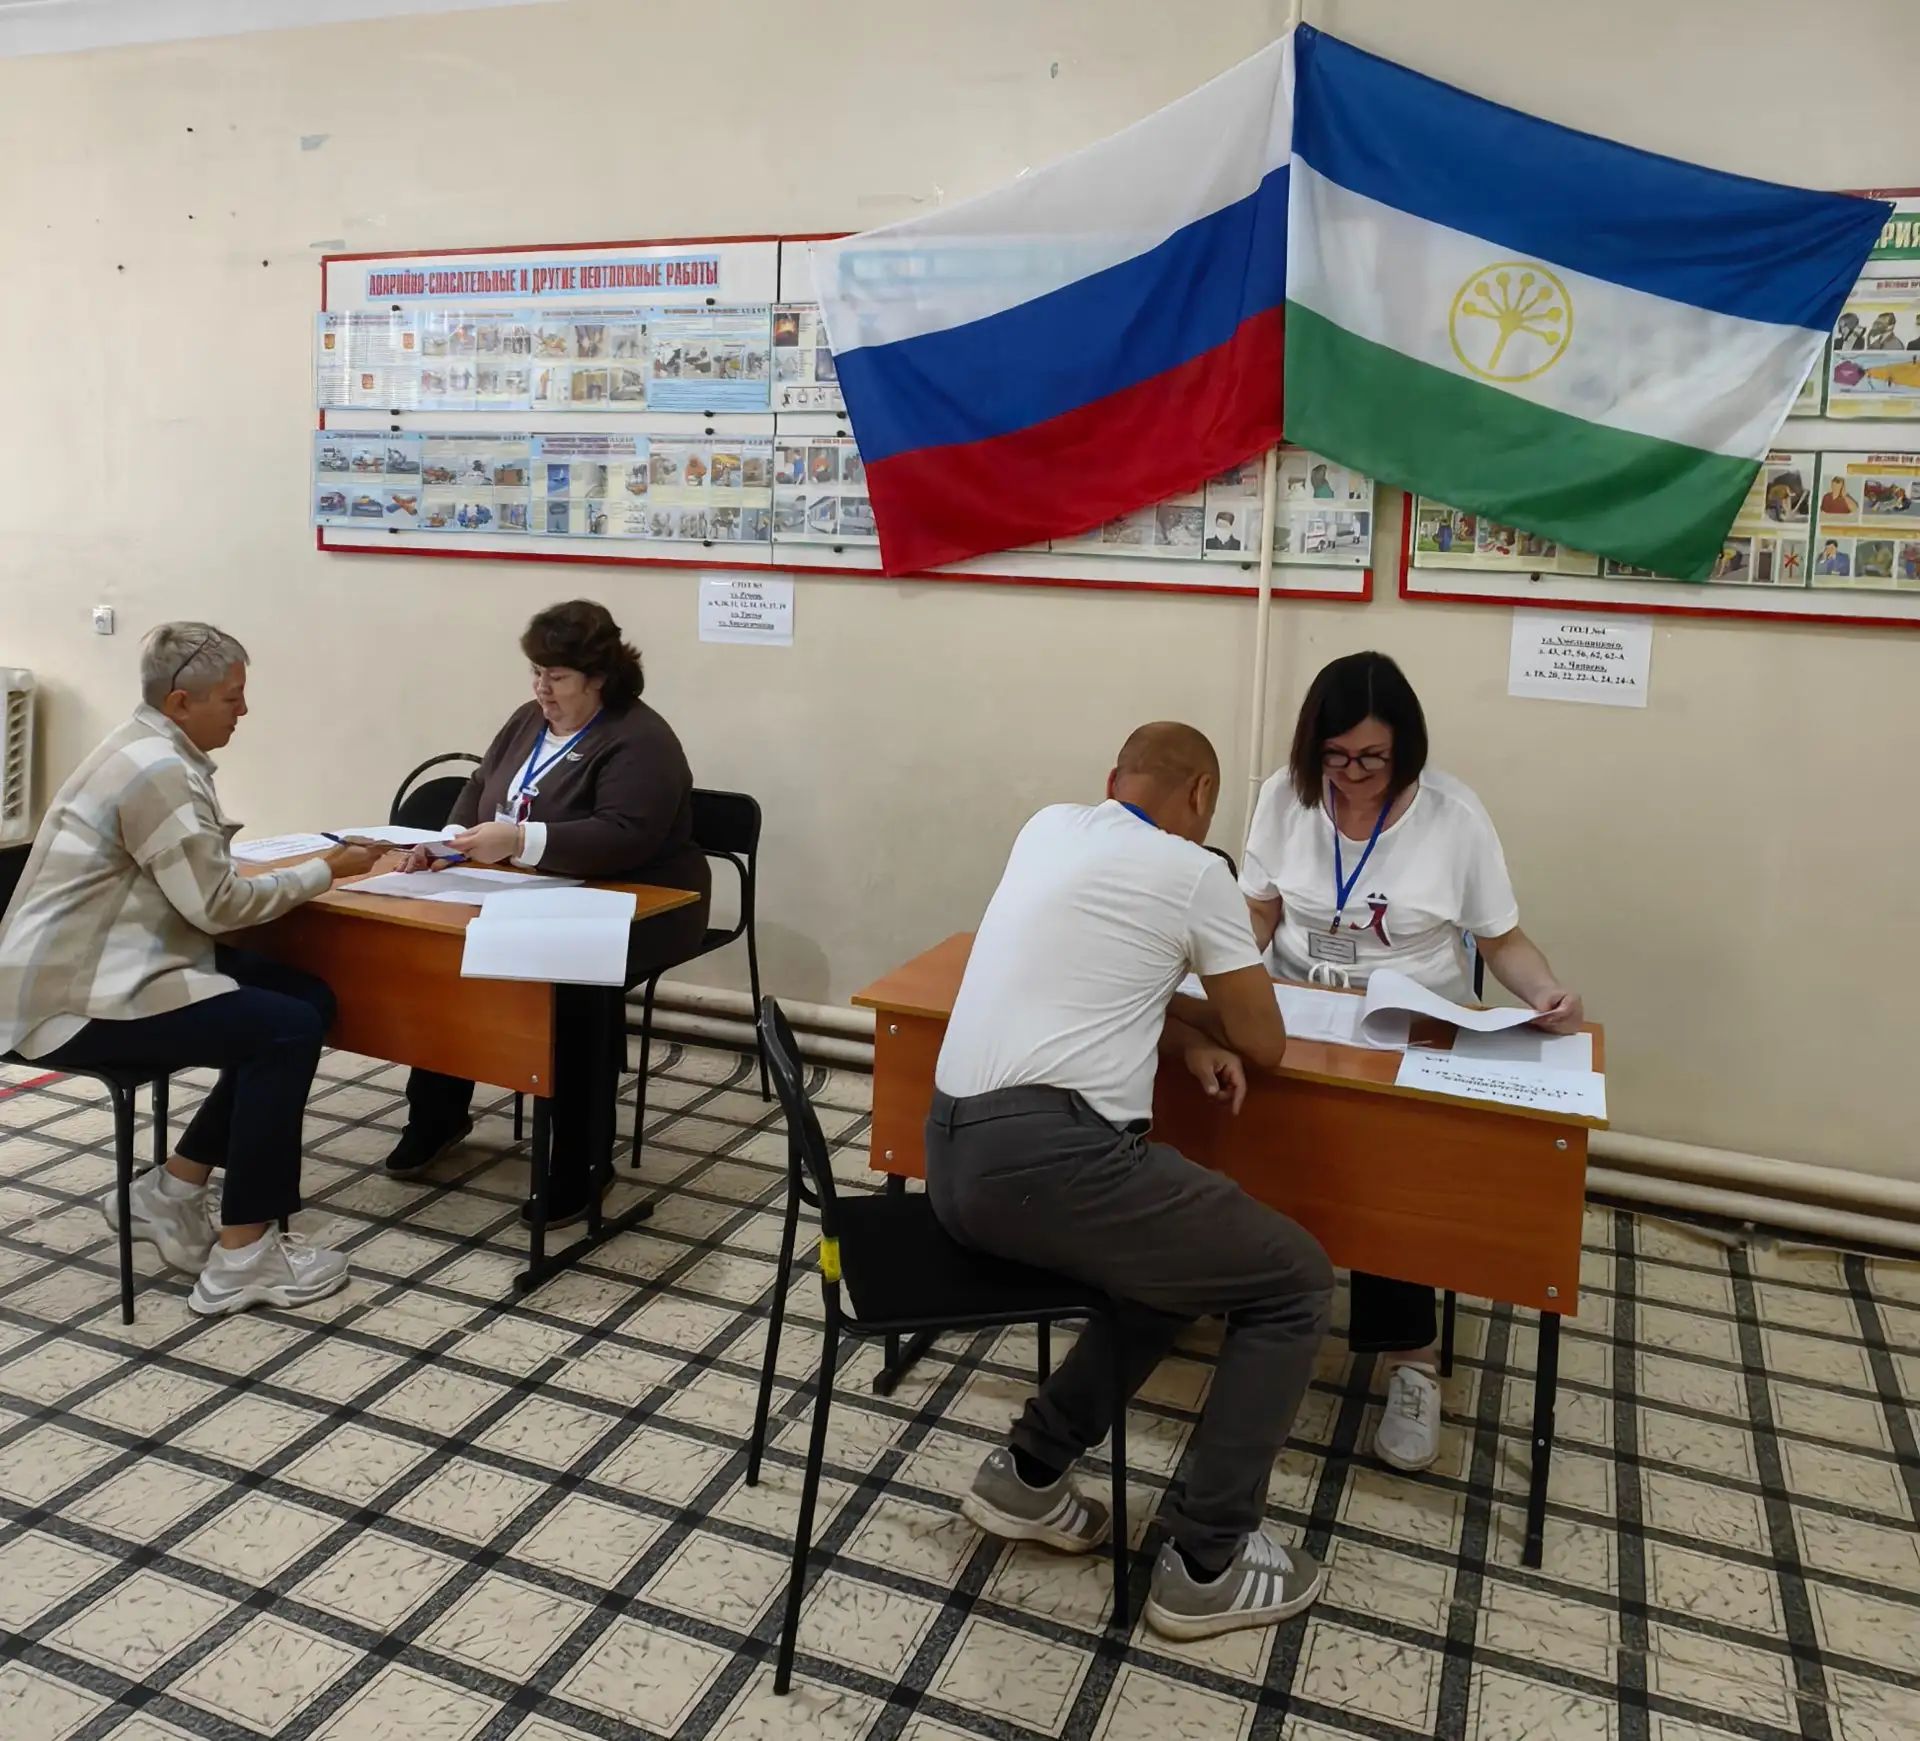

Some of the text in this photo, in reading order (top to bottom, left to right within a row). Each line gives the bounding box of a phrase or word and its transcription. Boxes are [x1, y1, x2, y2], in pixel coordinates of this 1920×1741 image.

[1873, 221, 1920, 249] РИЯ
[369, 261, 718, 296] АВАРИЙНО-СПАСАТЕЛЬНЫЕ И ДРУГИЕ НЕОТЛОЖНЫЕ РАБОТЫ
[1560, 625, 1589, 635] СТОЛ
